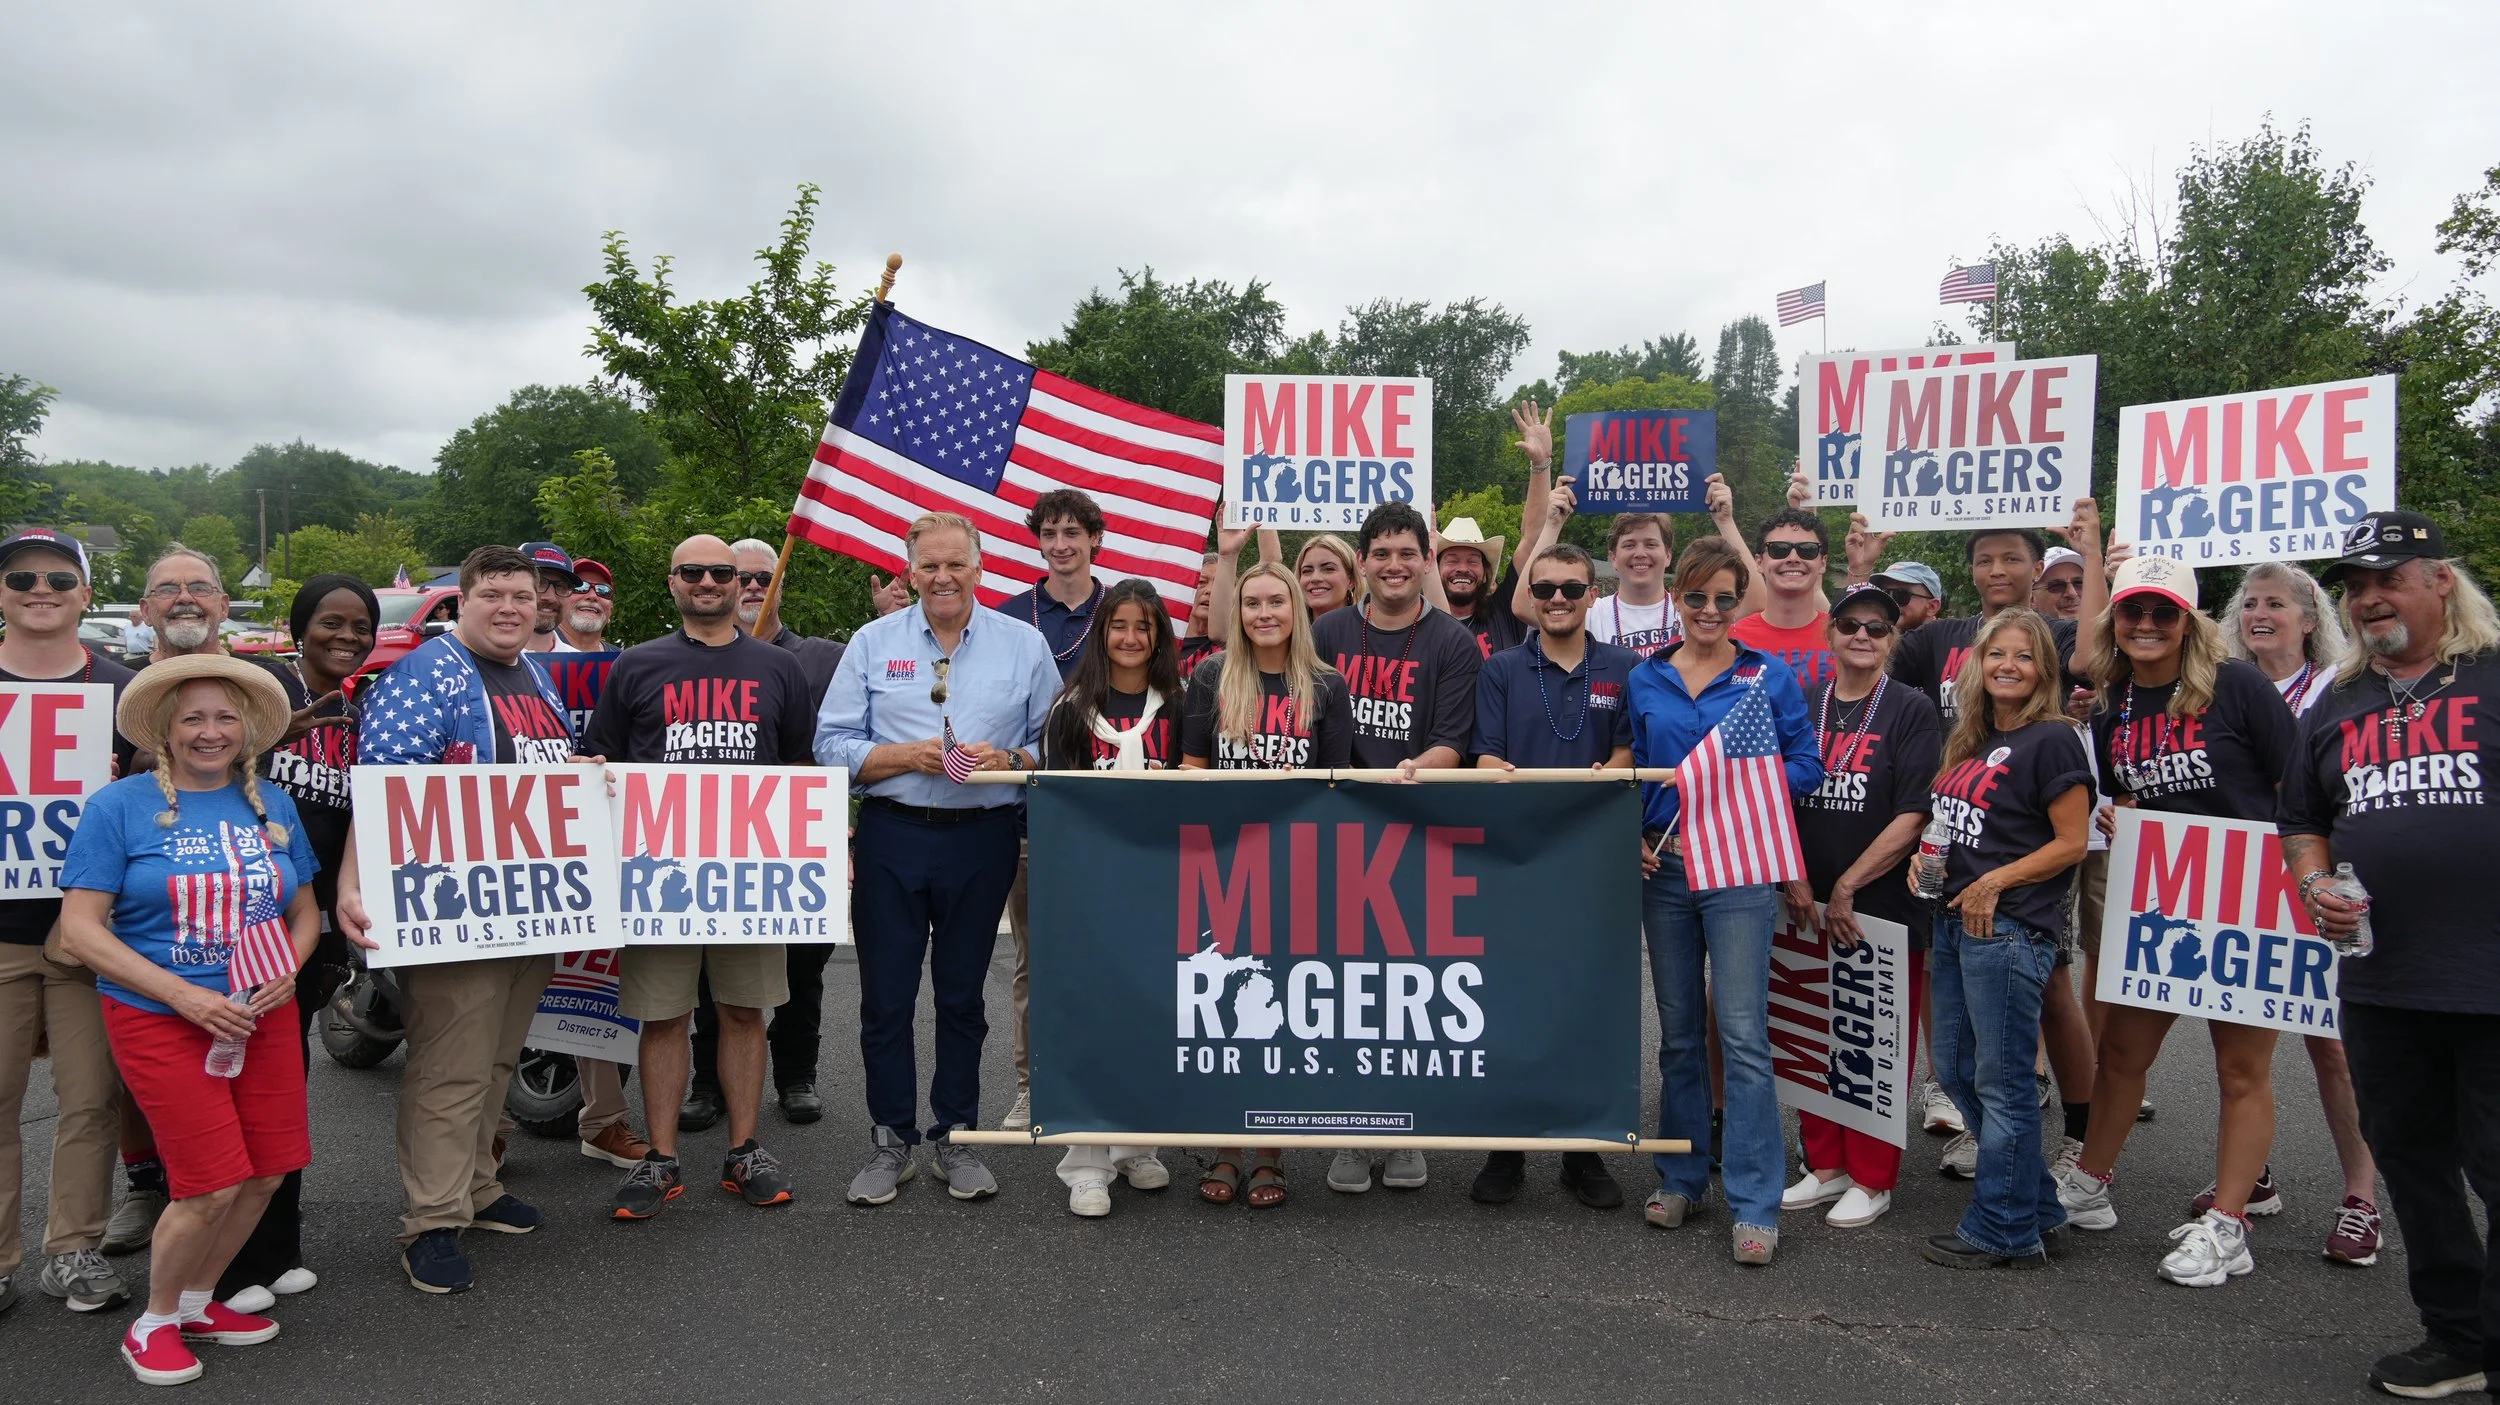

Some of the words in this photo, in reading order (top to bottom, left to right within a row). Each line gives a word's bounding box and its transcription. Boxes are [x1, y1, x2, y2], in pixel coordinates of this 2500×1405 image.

[1243, 382, 1415, 458] MIKE
[1886, 366, 2069, 452] MIKE
[1589, 417, 1691, 463] MIKE
[2140, 386, 2369, 490] MIKE
[1242, 459, 1415, 505] ROGERS
[1588, 462, 1690, 490] ROGERS
[1883, 446, 2063, 498] ROGERS
[1588, 491, 1611, 501] FOR
[1616, 491, 1641, 501] U.S.
[1646, 490, 1690, 501] SENATE
[1818, 484, 1854, 500] FOR
[1881, 501, 1918, 518] FOR
[1931, 499, 1971, 517] U.S.
[1984, 495, 2062, 515] SENATE
[2139, 474, 2368, 541] ROGERS
[1241, 506, 1278, 523] FOR
[1290, 507, 1331, 524] U.S.
[2137, 557, 2175, 570] AMERICAN
[2200, 541, 2252, 560] U.S.
[887, 659, 917, 672] MIKE
[1336, 653, 1420, 703] MIKE
[664, 677, 761, 726] MIKE
[665, 720, 759, 752] ROGERS
[1374, 727, 1411, 741] SENATE
[2340, 695, 2480, 772] MIKE
[663, 751, 683, 763] FOR
[688, 750, 713, 760] U.S.
[718, 749, 756, 761] SENATE
[297, 786, 322, 803] U.S.
[1799, 796, 1818, 809] U.S.
[1823, 798, 1866, 812] SENATE
[2142, 787, 2164, 800] U.S.
[2167, 777, 2217, 794] SENATE
[2374, 795, 2408, 810] U.S.
[2416, 791, 2485, 806] SENATE
[385, 773, 588, 866] MIKE
[621, 772, 828, 859] MIKE
[175, 836, 208, 848] 1776
[176, 845, 210, 856] 2026
[233, 824, 262, 857] 250
[391, 860, 593, 923] ROGERS
[620, 860, 828, 913] ROGERS
[1176, 822, 1485, 956] MIKE
[397, 926, 443, 948] FOR
[456, 921, 504, 943] U.S.
[517, 915, 597, 939] SENATE
[678, 917, 728, 937] U.S.
[741, 917, 828, 937] SENATE
[1878, 944, 1895, 1020] SENATE
[2121, 975, 2172, 1003] FOR
[2188, 986, 2245, 1015] U.S.
[1176, 958, 1485, 1043] ROGERS
[603, 1027, 619, 1040] 54
[1176, 1046, 1242, 1074] FOR
[1263, 1046, 1335, 1075] U.S.
[1356, 1048, 1486, 1078] SENATE
[1877, 1031, 1894, 1071] U.S.
[1876, 1079, 1894, 1119] FOR
[1254, 1115, 1276, 1125] PAID
[1277, 1115, 1297, 1125] FOR
[1297, 1115, 1310, 1125] BY
[1311, 1115, 1349, 1125] ROGERS
[1350, 1116, 1369, 1126] FOR
[1369, 1116, 1406, 1126] SENATE
